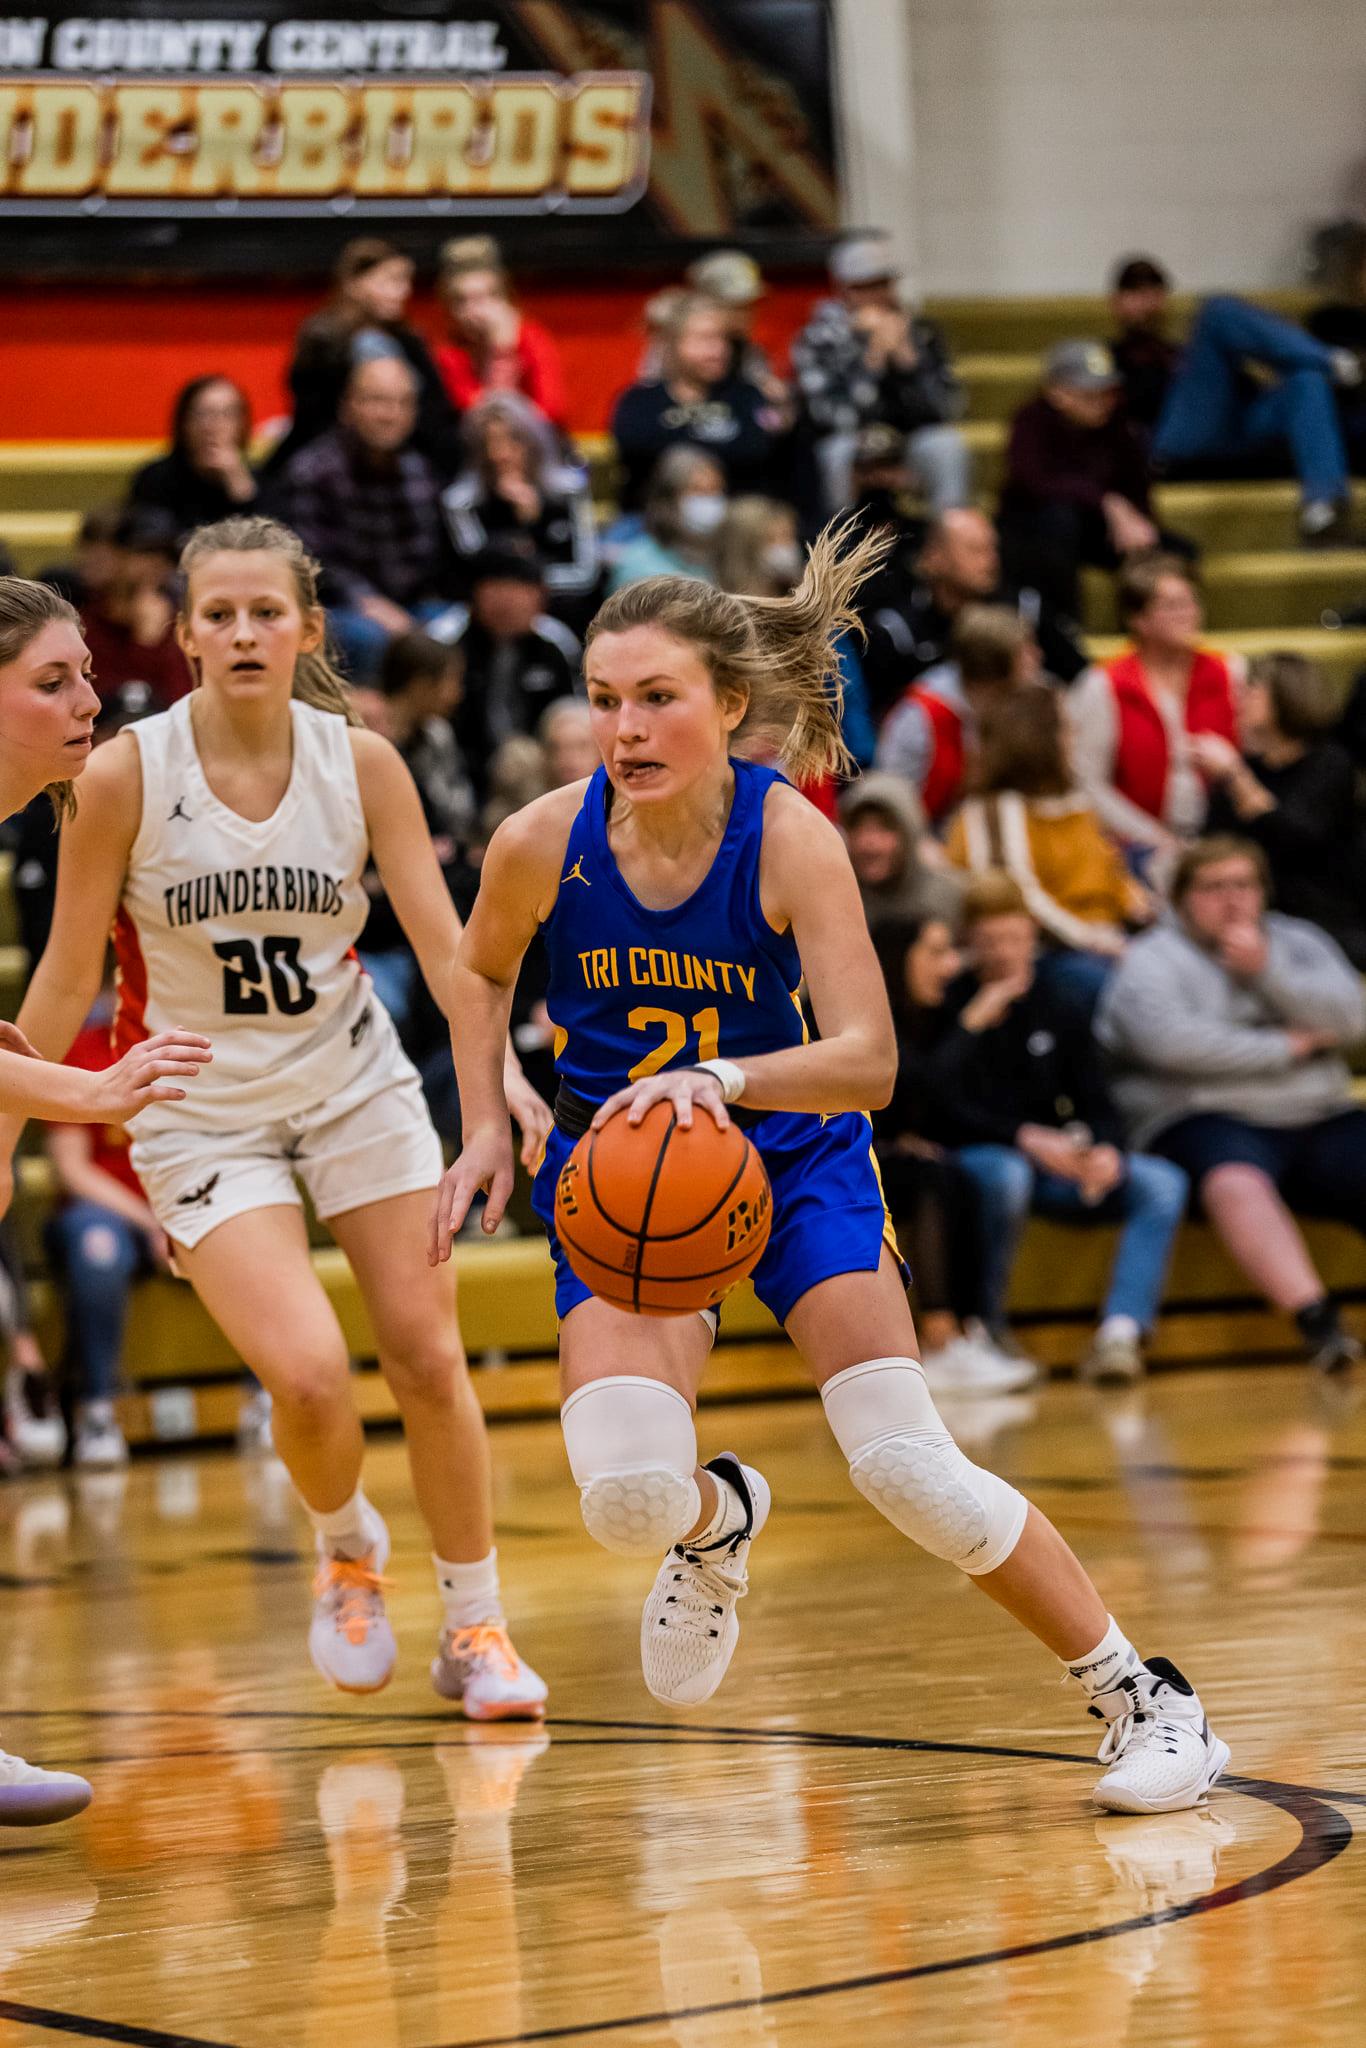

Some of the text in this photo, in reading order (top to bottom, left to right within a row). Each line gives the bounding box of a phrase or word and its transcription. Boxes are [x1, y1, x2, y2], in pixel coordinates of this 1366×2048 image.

[51, 19, 267, 70] COUNTY
[268, 19, 507, 70] CENTRAL
[0, 84, 640, 195] DERBIRDS
[163, 865, 343, 928] THUNDERBIRDS
[212, 935, 317, 1016] 20
[577, 946, 756, 1002] TRI COUNTY
[627, 1005, 721, 1084] 21
